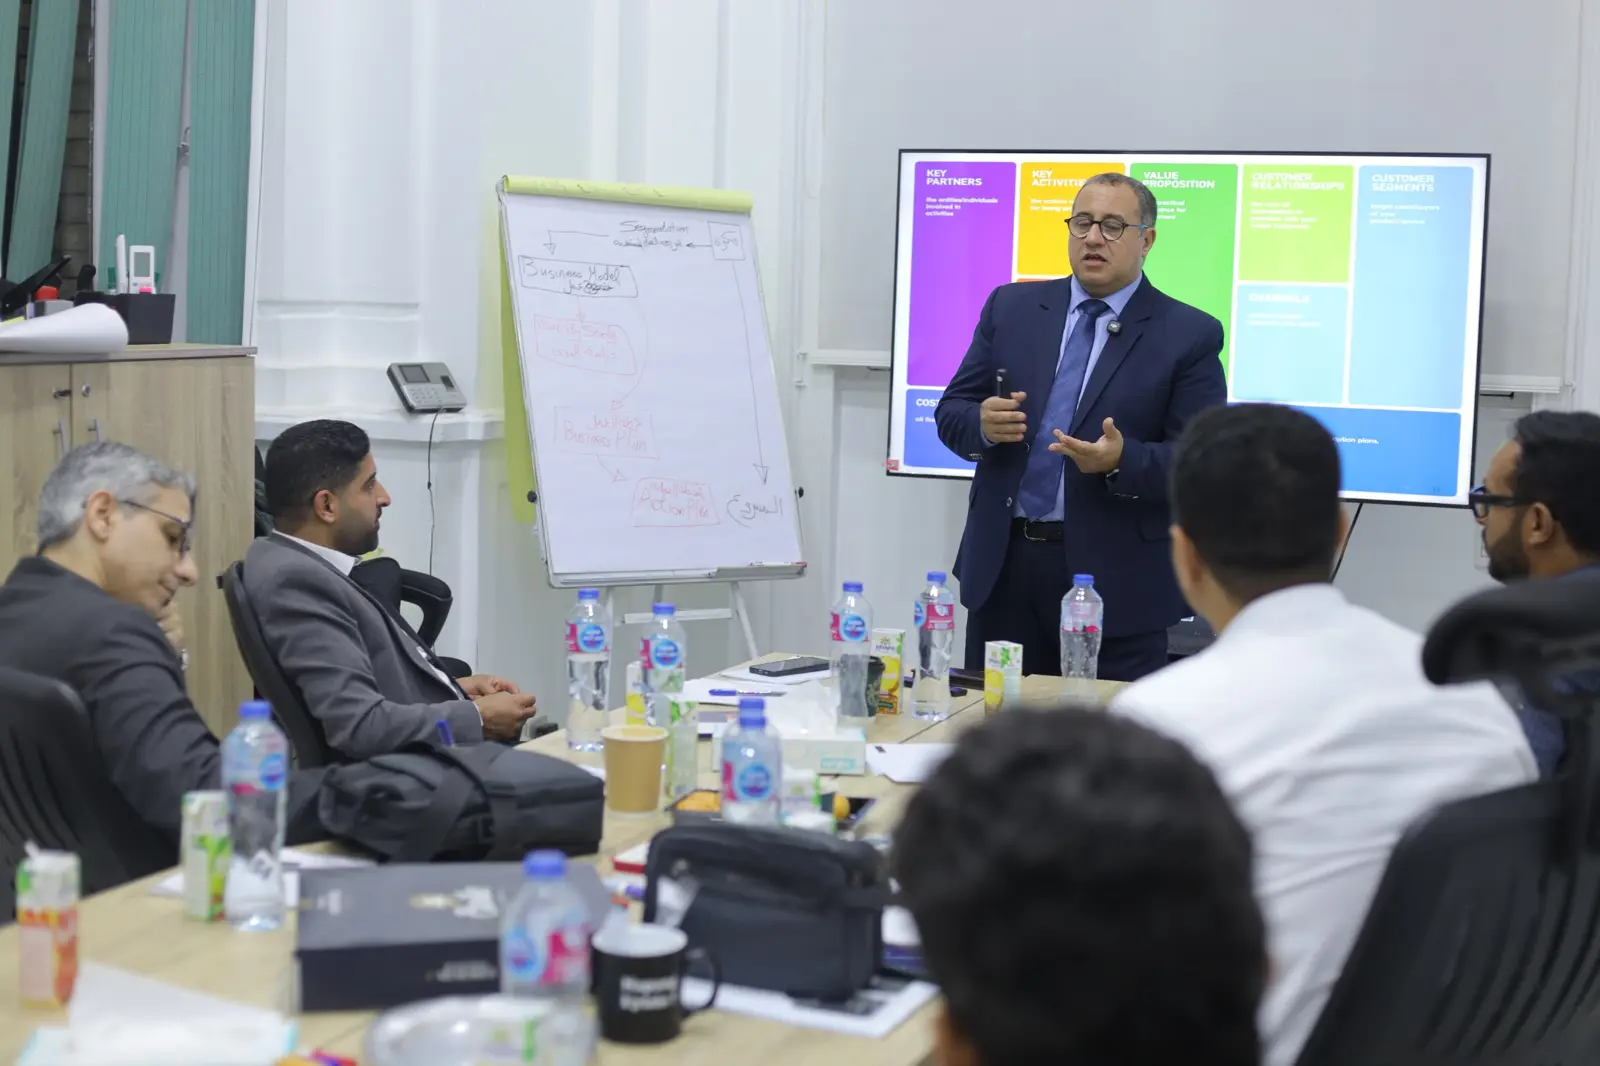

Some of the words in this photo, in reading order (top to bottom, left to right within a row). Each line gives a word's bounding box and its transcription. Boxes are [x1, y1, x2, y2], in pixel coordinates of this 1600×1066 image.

[926, 169, 948, 177] KEY
[1031, 169, 1053, 178] KEY
[1143, 171, 1179, 179] VALUE
[1251, 172, 1313, 181] CUSTOMER
[926, 177, 983, 186] PARTNERS
[1031, 178, 1087, 187] ACTIVITIE
[1371, 174, 1435, 183] CUSTOMER
[1142, 179, 1215, 189] PROPOSITION
[1251, 181, 1345, 191] RELATIONSHIPS
[1371, 183, 1435, 192] SEGMENTS
[522, 260, 583, 279] Business
[589, 264, 620, 284] Model
